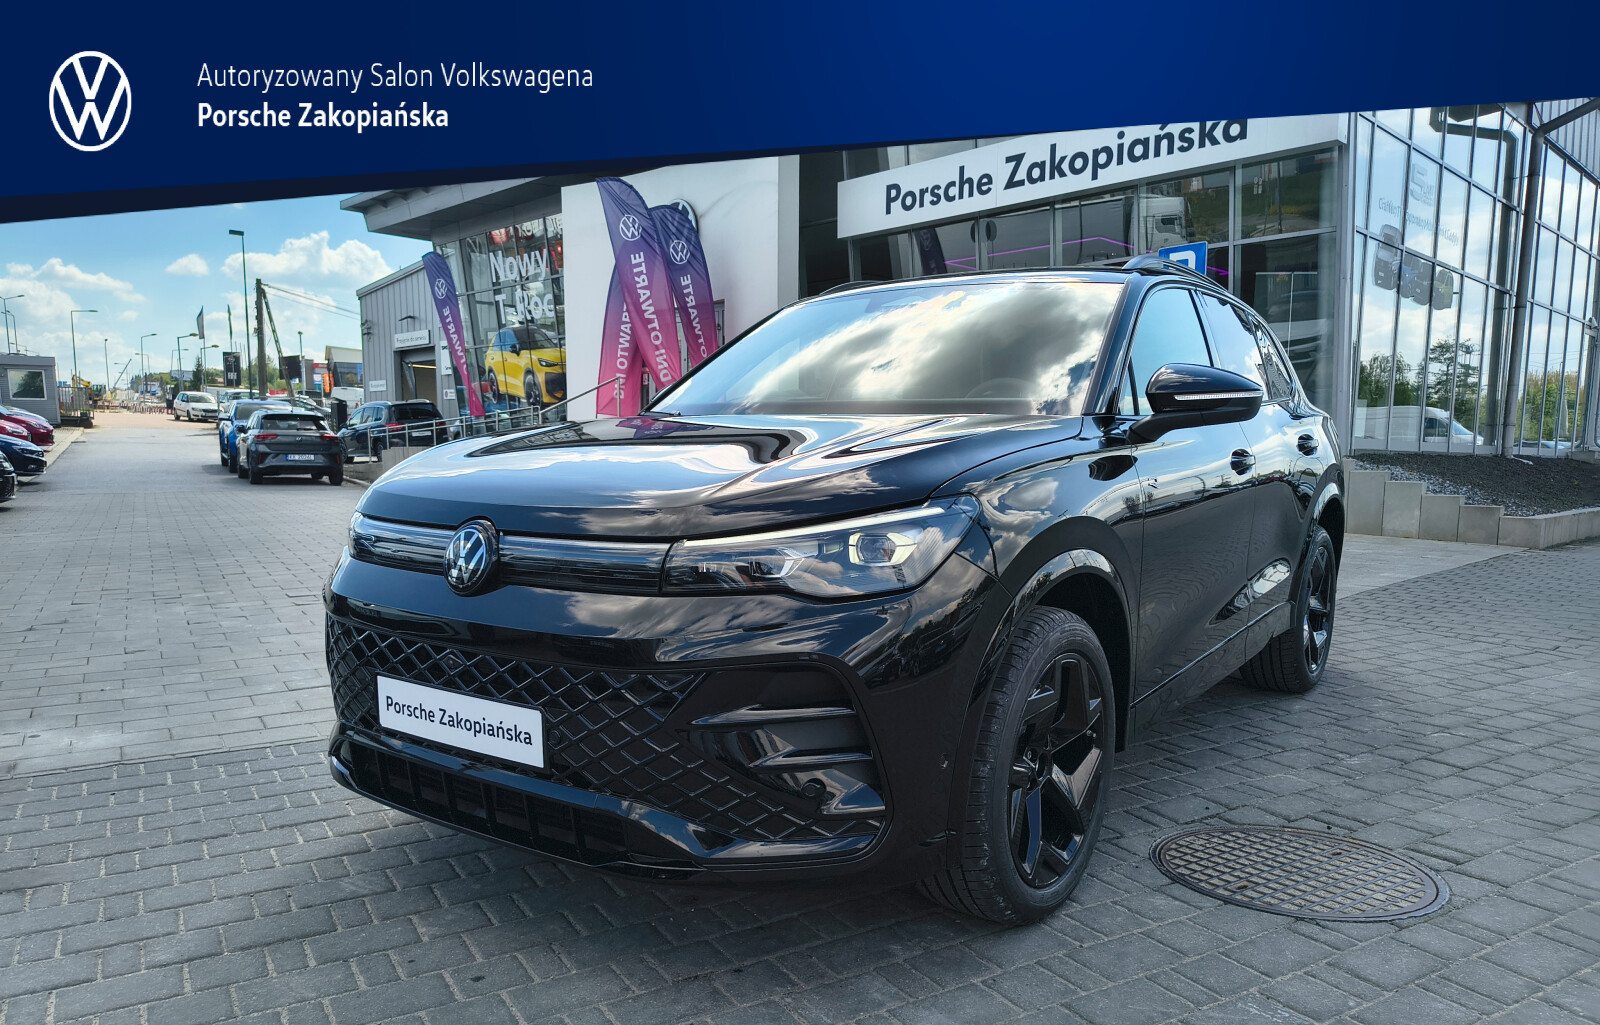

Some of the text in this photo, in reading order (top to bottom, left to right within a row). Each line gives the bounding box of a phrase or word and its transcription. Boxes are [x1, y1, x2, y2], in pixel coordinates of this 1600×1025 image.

[885, 118, 1248, 215] Porsche Zakopiańska
[489, 248, 547, 283] Nowy
[385, 695, 533, 746] Porsche Zakopiańska
